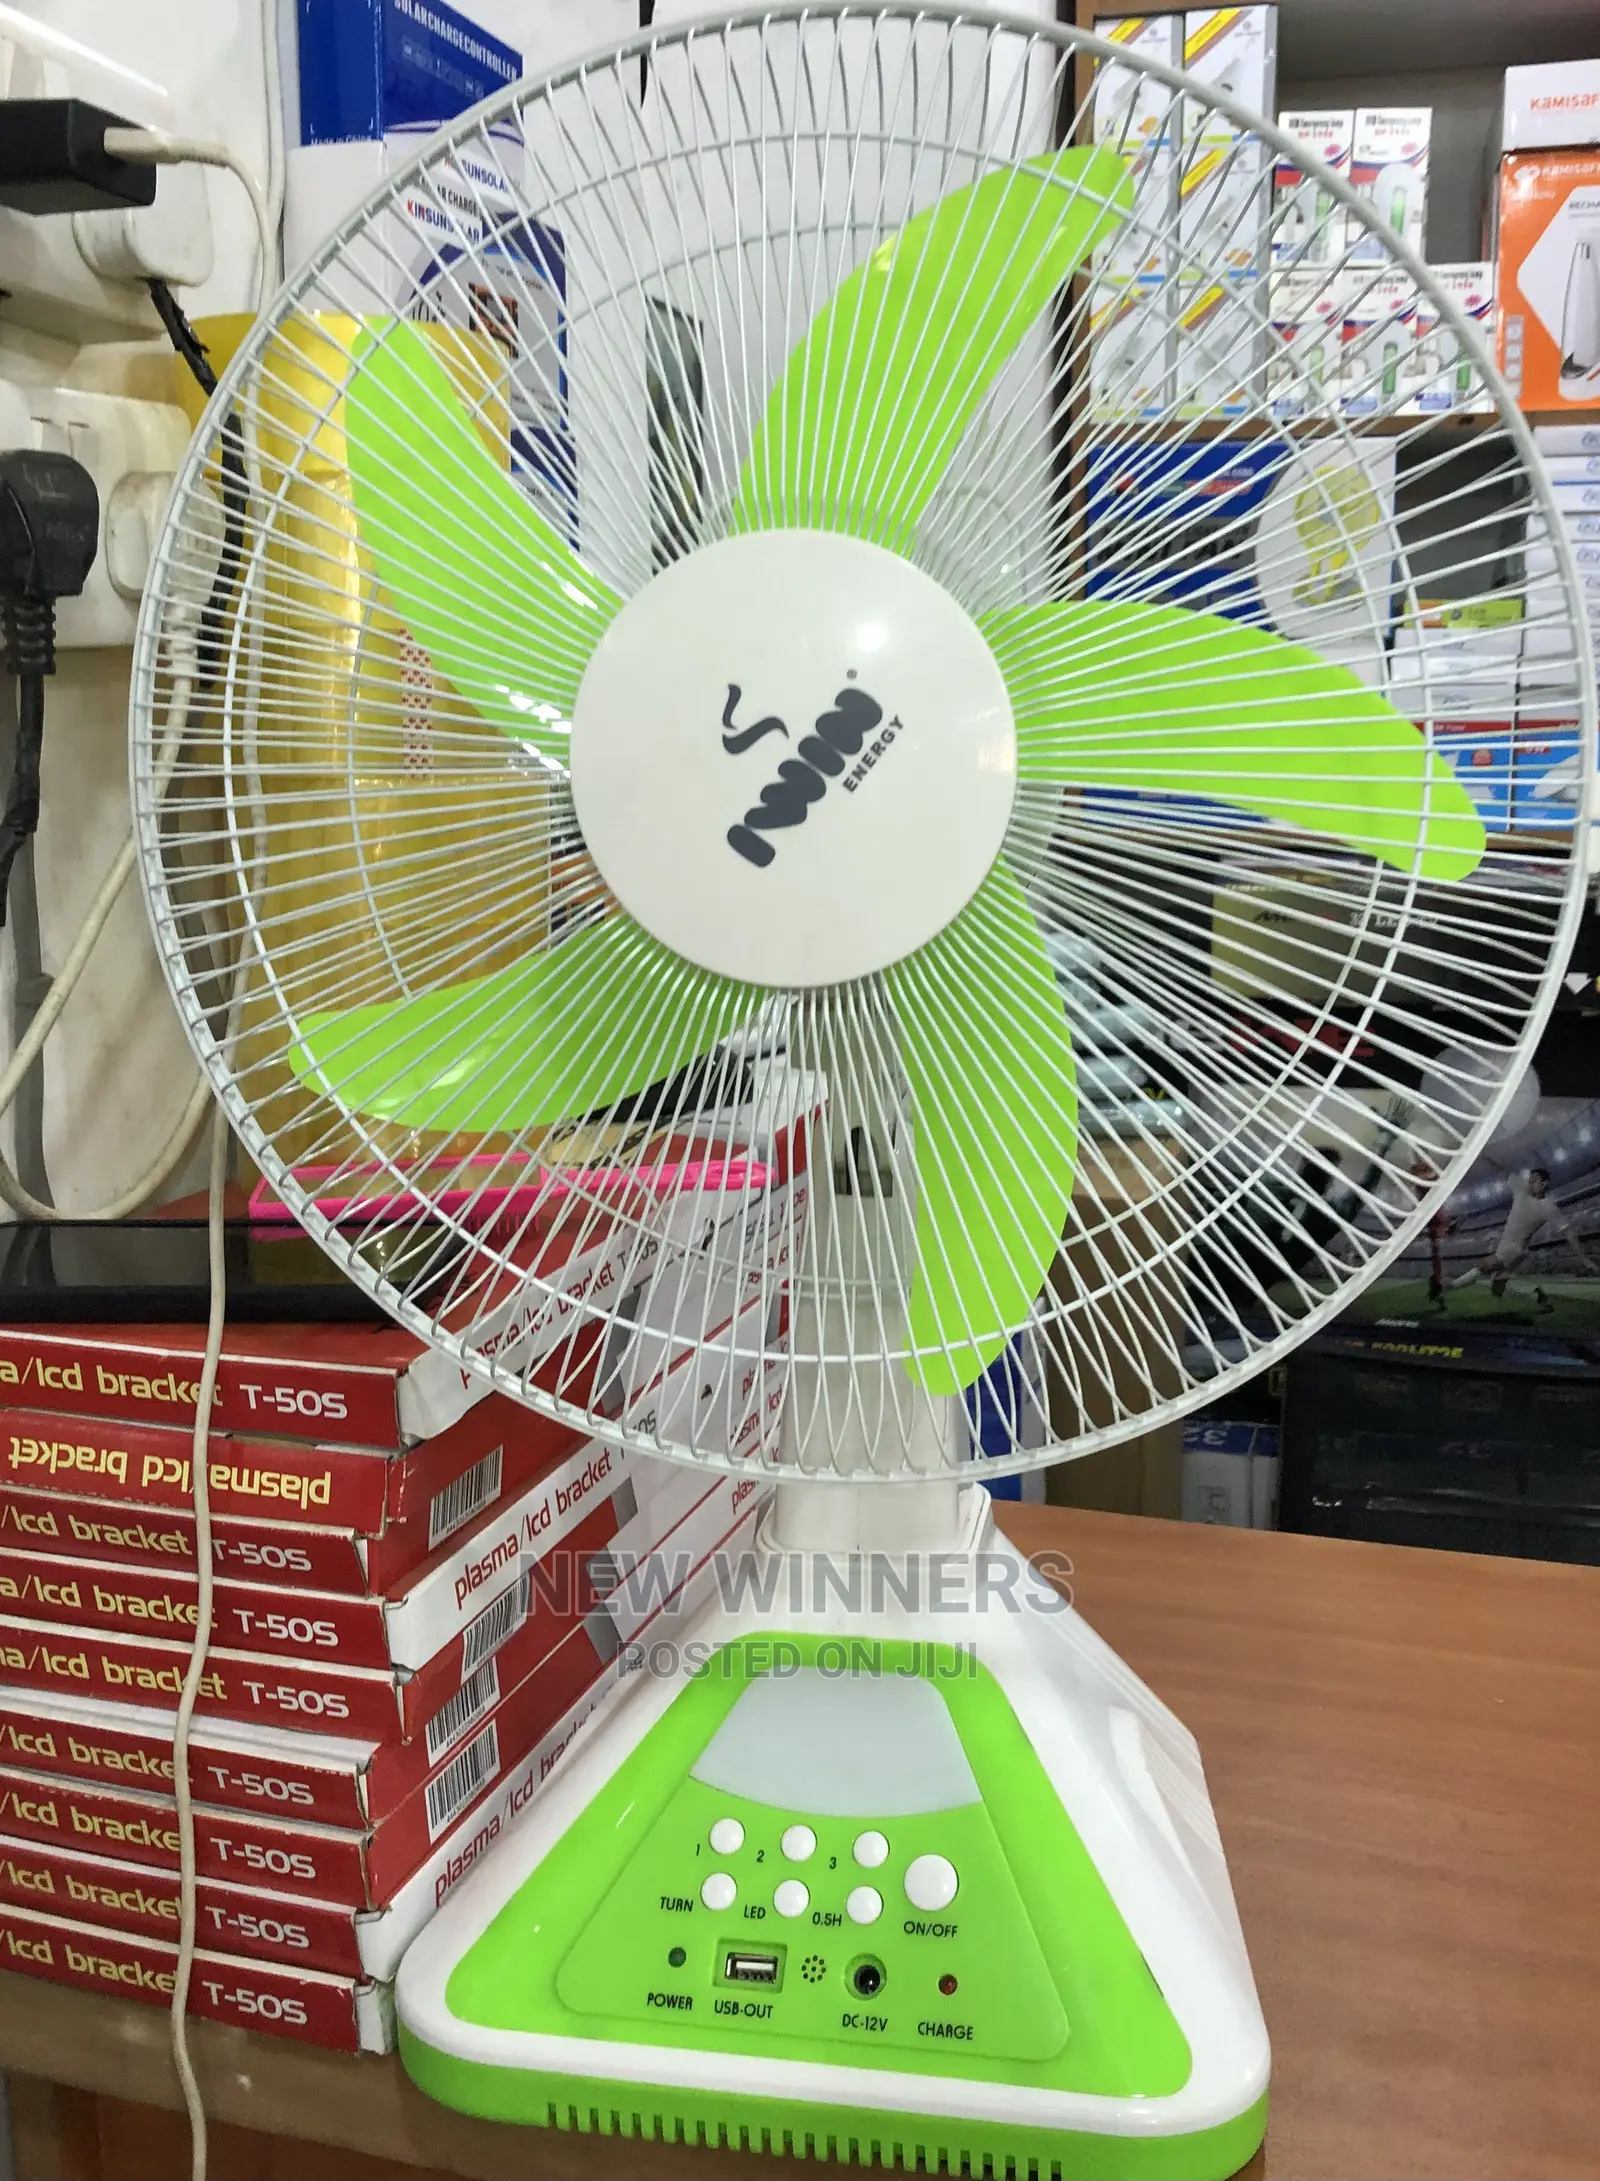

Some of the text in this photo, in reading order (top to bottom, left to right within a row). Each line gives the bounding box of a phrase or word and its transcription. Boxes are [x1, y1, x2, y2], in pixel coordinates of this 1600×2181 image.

[406, 199, 480, 244] KINSUNSAR
[842, 715, 904, 792] ENERGY
[239, 1384, 348, 1419] T-50S
[9, 1437, 331, 1511] plasmalcd bracket
[69, 1514, 192, 1556] bracket
[211, 1539, 312, 1572] T-50S
[454, 1497, 552, 1611] plasma/lcd
[555, 1446, 613, 1516] bracket
[233, 1608, 339, 1647] T-50S
[243, 1680, 350, 1718] T-50S
[69, 1737, 193, 1782] bracke
[208, 1766, 314, 1805] T-50S
[71, 1805, 182, 1852] bracke
[210, 1837, 316, 1879] T-50S
[435, 1769, 534, 1910] plasma/lcd
[694, 1843, 700, 1857] 1
[756, 1849, 765, 1863] 2
[829, 1856, 837, 1870] 3
[660, 1896, 694, 1912] TURN
[743, 1904, 766, 1920] LED
[812, 1911, 842, 1927] 0.5H
[205, 1906, 310, 1949] T-50S
[903, 1921, 958, 1938] ON/OFF
[202, 1980, 308, 2025] T-50S
[647, 1992, 693, 2011] POWER
[714, 1999, 774, 2019] USB-OUT
[842, 2014, 888, 2032] DC-12V
[917, 2021, 973, 2041] CHARGE
